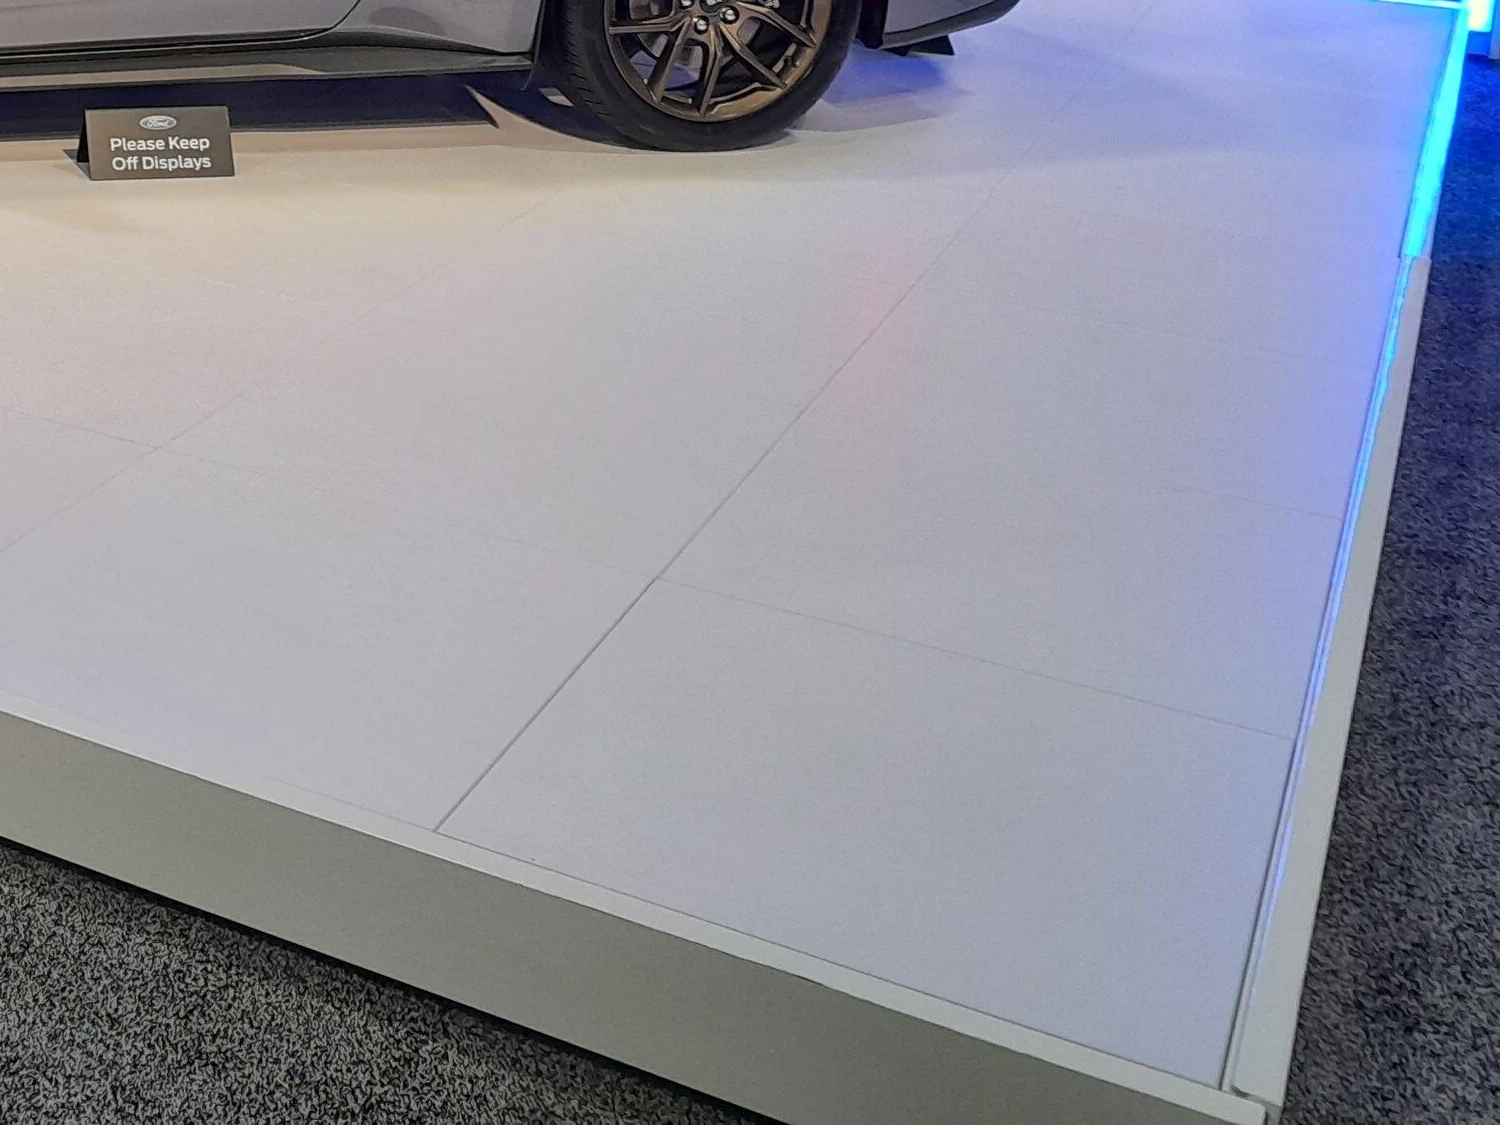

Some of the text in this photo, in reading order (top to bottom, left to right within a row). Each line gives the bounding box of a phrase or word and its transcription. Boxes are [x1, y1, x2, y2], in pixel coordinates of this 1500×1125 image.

[109, 136, 210, 152] Please Keep
[112, 155, 212, 171] Off Displays
